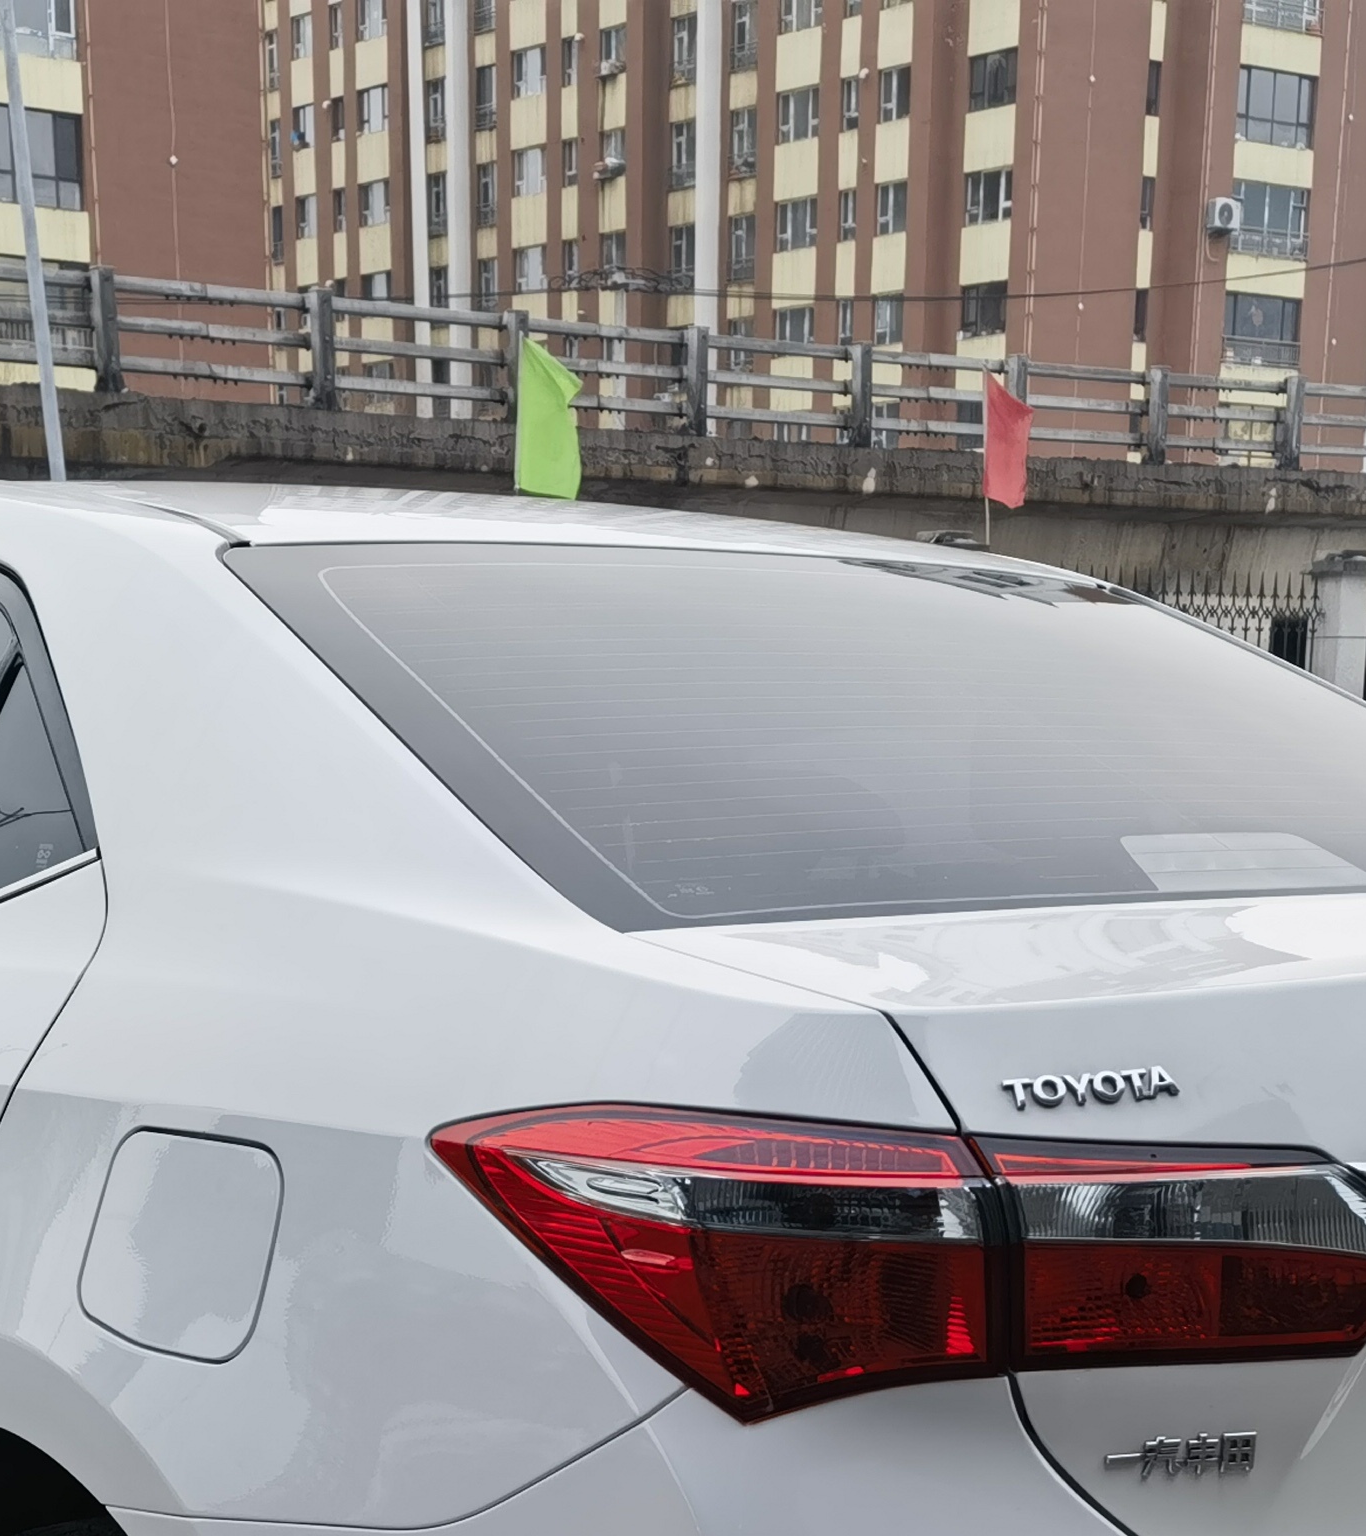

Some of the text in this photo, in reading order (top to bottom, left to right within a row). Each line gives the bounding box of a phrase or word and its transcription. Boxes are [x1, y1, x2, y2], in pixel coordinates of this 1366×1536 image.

[1001, 1065, 1181, 1111] TOYOTA
[1103, 1430, 1258, 1478] 一汽丰田
